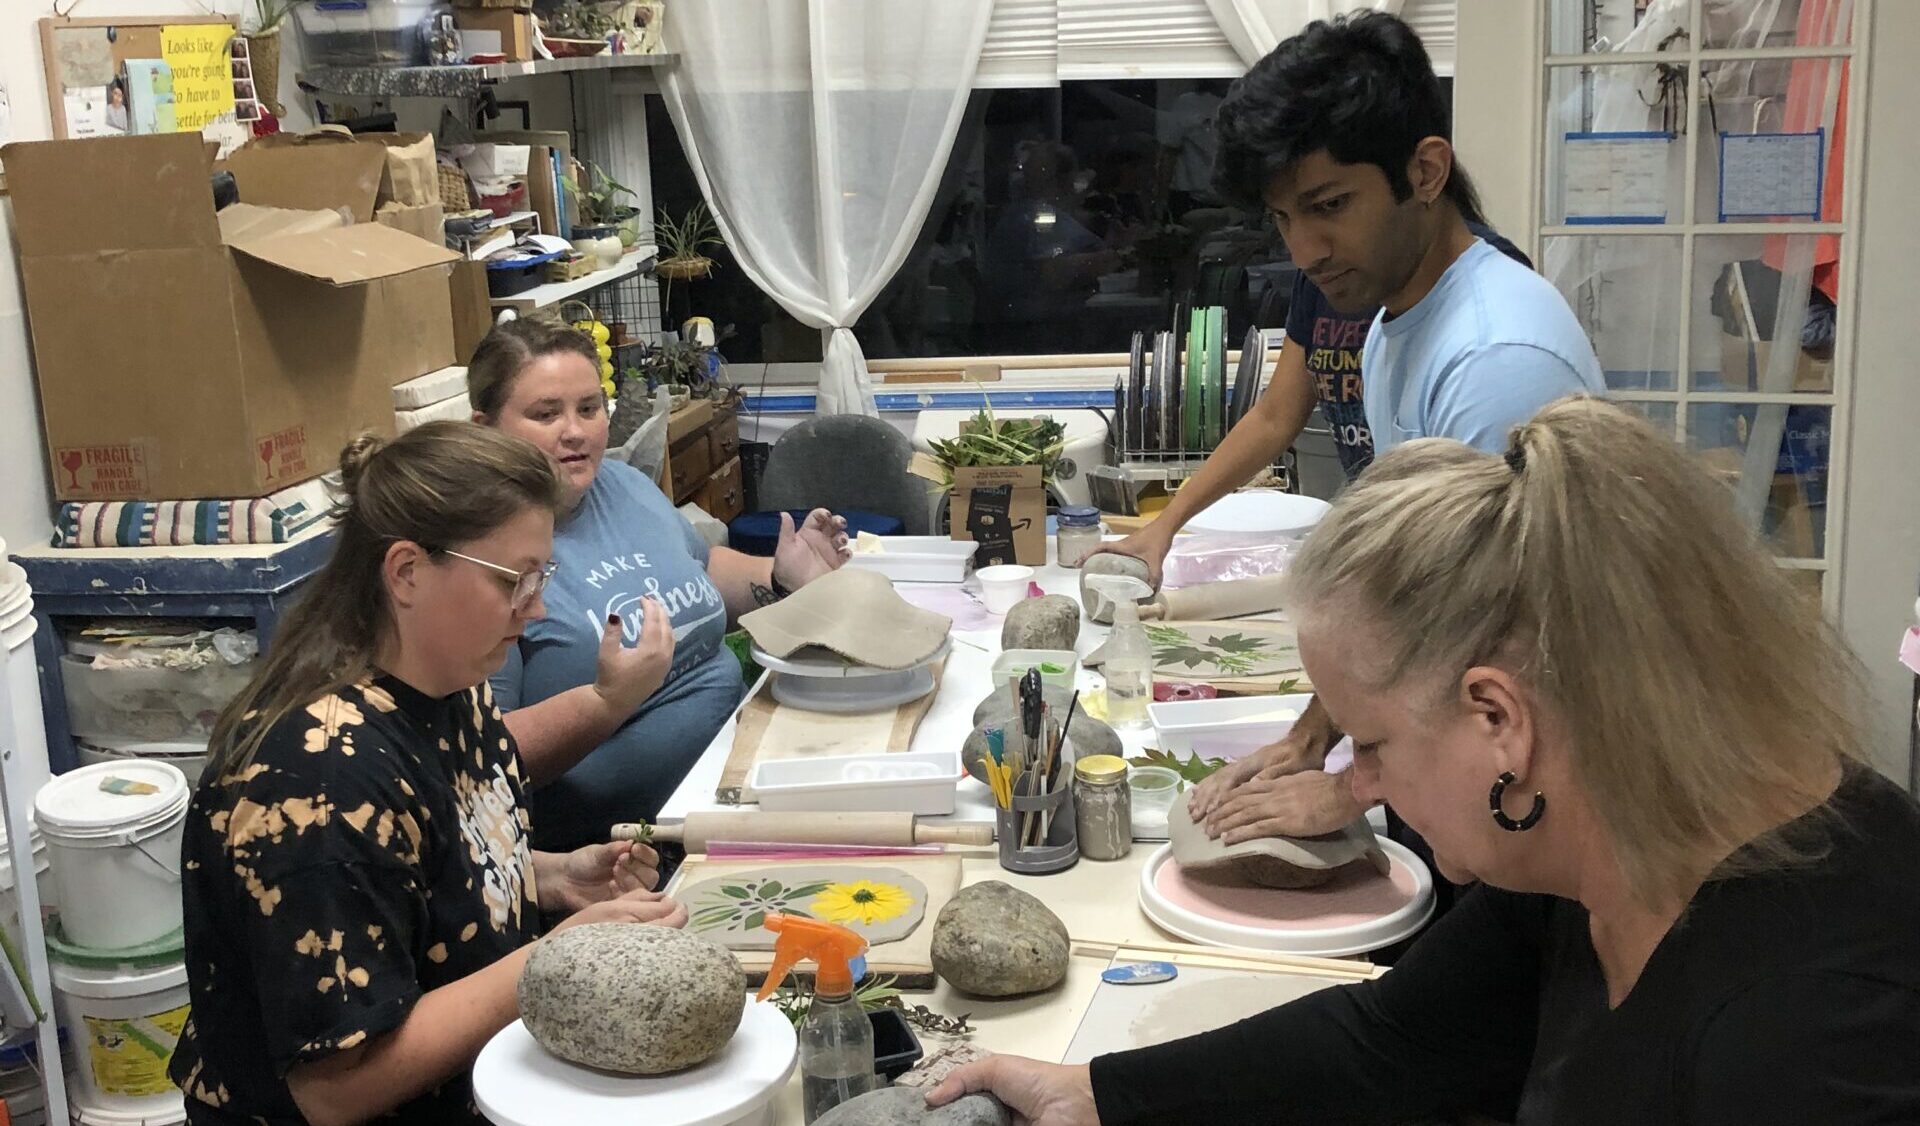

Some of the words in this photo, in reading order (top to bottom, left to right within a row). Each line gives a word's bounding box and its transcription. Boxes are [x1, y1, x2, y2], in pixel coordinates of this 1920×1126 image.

[167, 38, 195, 55] Looks
[199, 38, 213, 54] like
[171, 64, 201, 80] you're
[203, 63, 225, 81] going
[186, 87, 209, 104] have
[211, 88, 221, 101] to
[176, 112, 201, 128] settle
[203, 110, 217, 131] for
[85, 446, 142, 465] FRAGILE
[96, 466, 134, 480] HANDLE
[91, 480, 116, 493] WITH
[118, 479, 143, 492] CARE
[585, 553, 653, 590] MAKE
